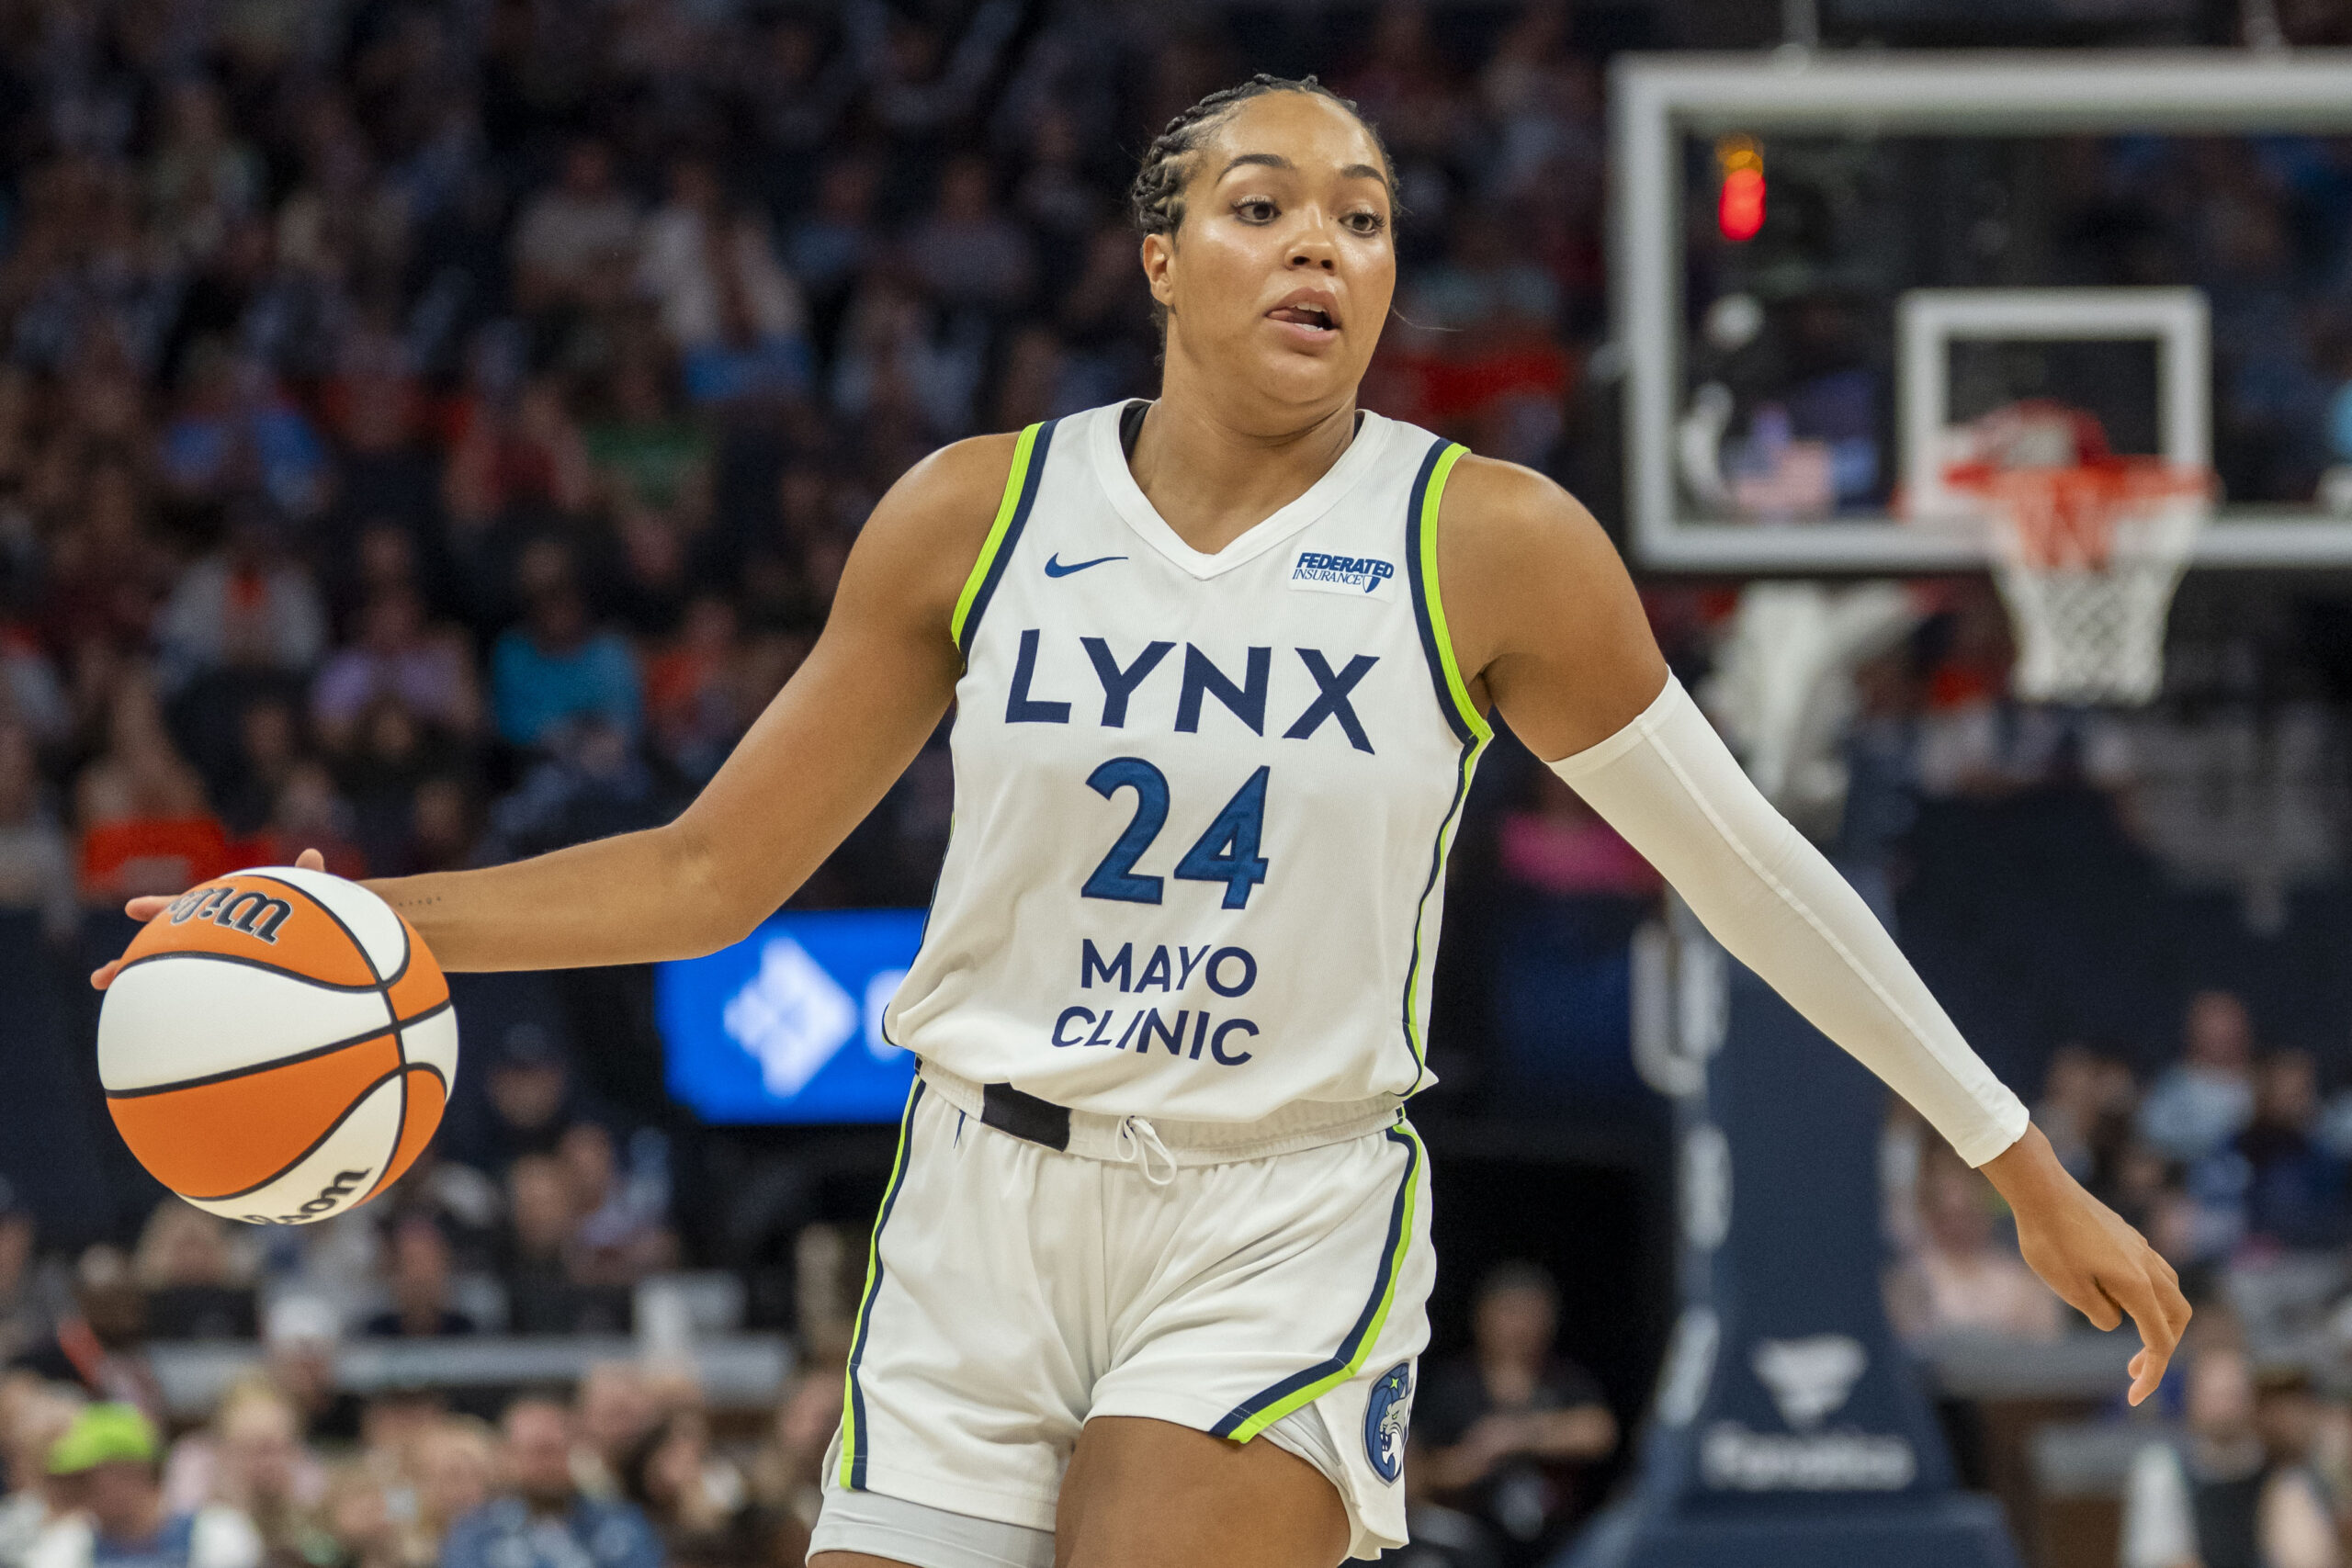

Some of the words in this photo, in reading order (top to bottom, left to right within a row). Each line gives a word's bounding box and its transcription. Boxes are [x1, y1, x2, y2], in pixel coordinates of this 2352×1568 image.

[1292, 569, 1362, 585] INSURANCE
[1296, 552, 1395, 580] FEDERATED
[1005, 628, 1380, 755] LYNX
[1080, 756, 1271, 909] 24
[1080, 938, 1258, 998] MAYO
[1051, 1006, 1261, 1066] CLINIC
